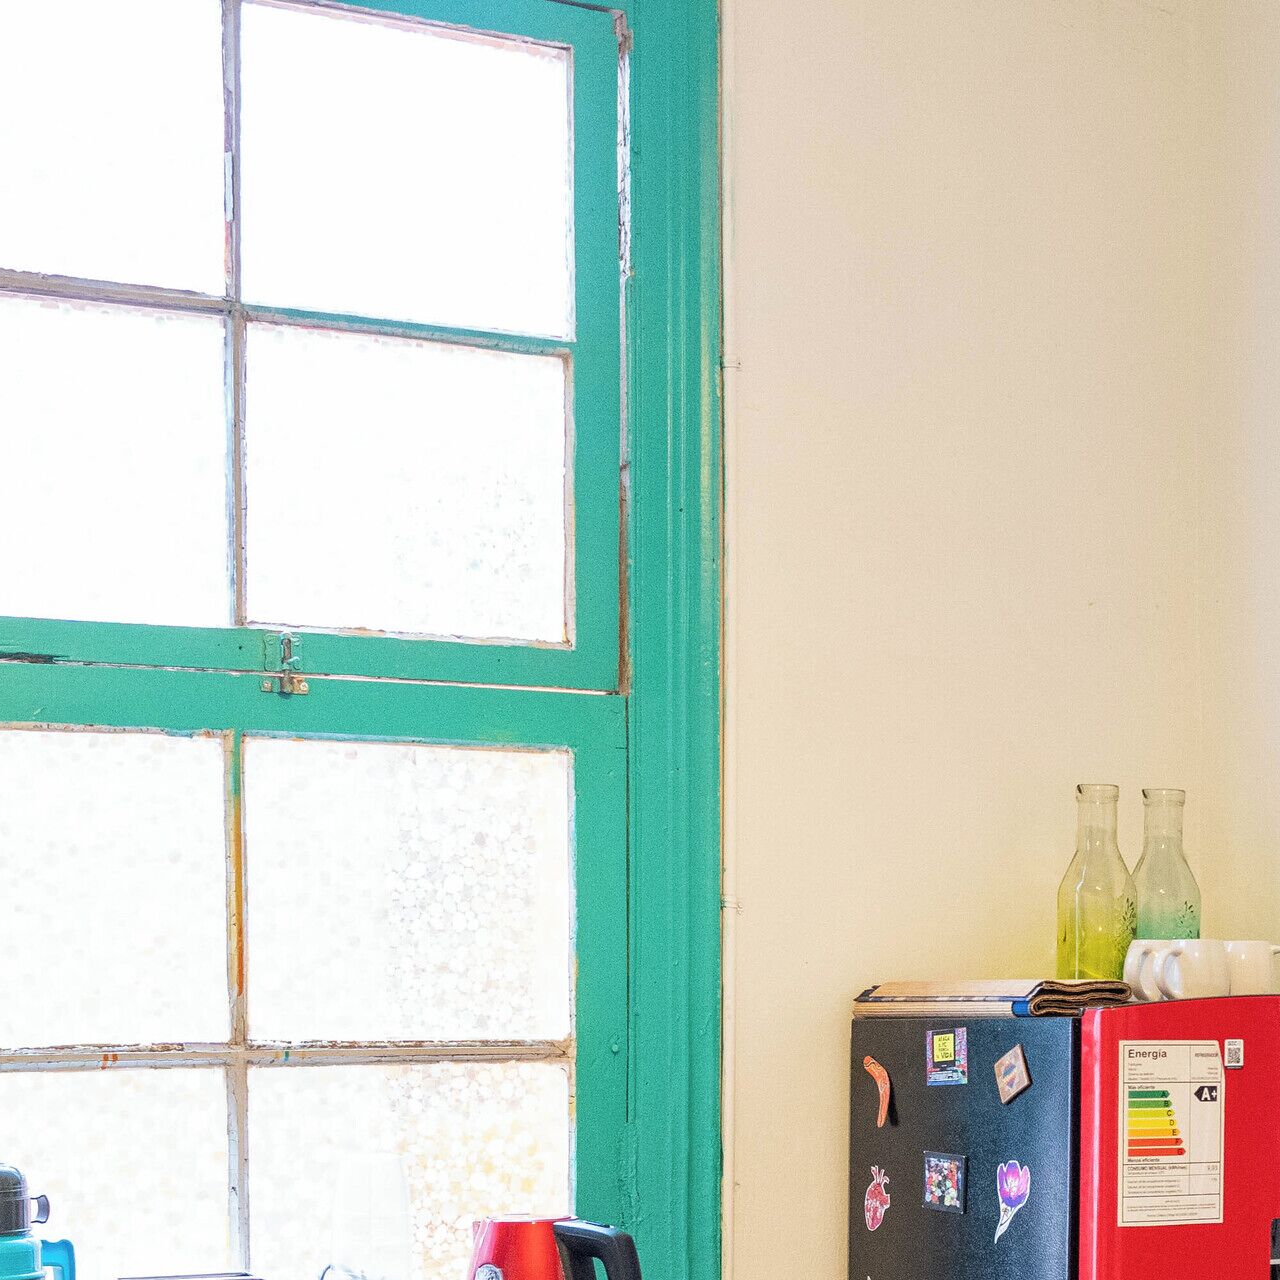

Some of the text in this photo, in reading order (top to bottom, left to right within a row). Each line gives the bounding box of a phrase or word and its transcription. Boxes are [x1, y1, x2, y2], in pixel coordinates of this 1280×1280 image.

[1128, 1049, 1167, 1060] Energía
[1201, 1087, 1218, 1101] A+
[1166, 1109, 1172, 1117] C
